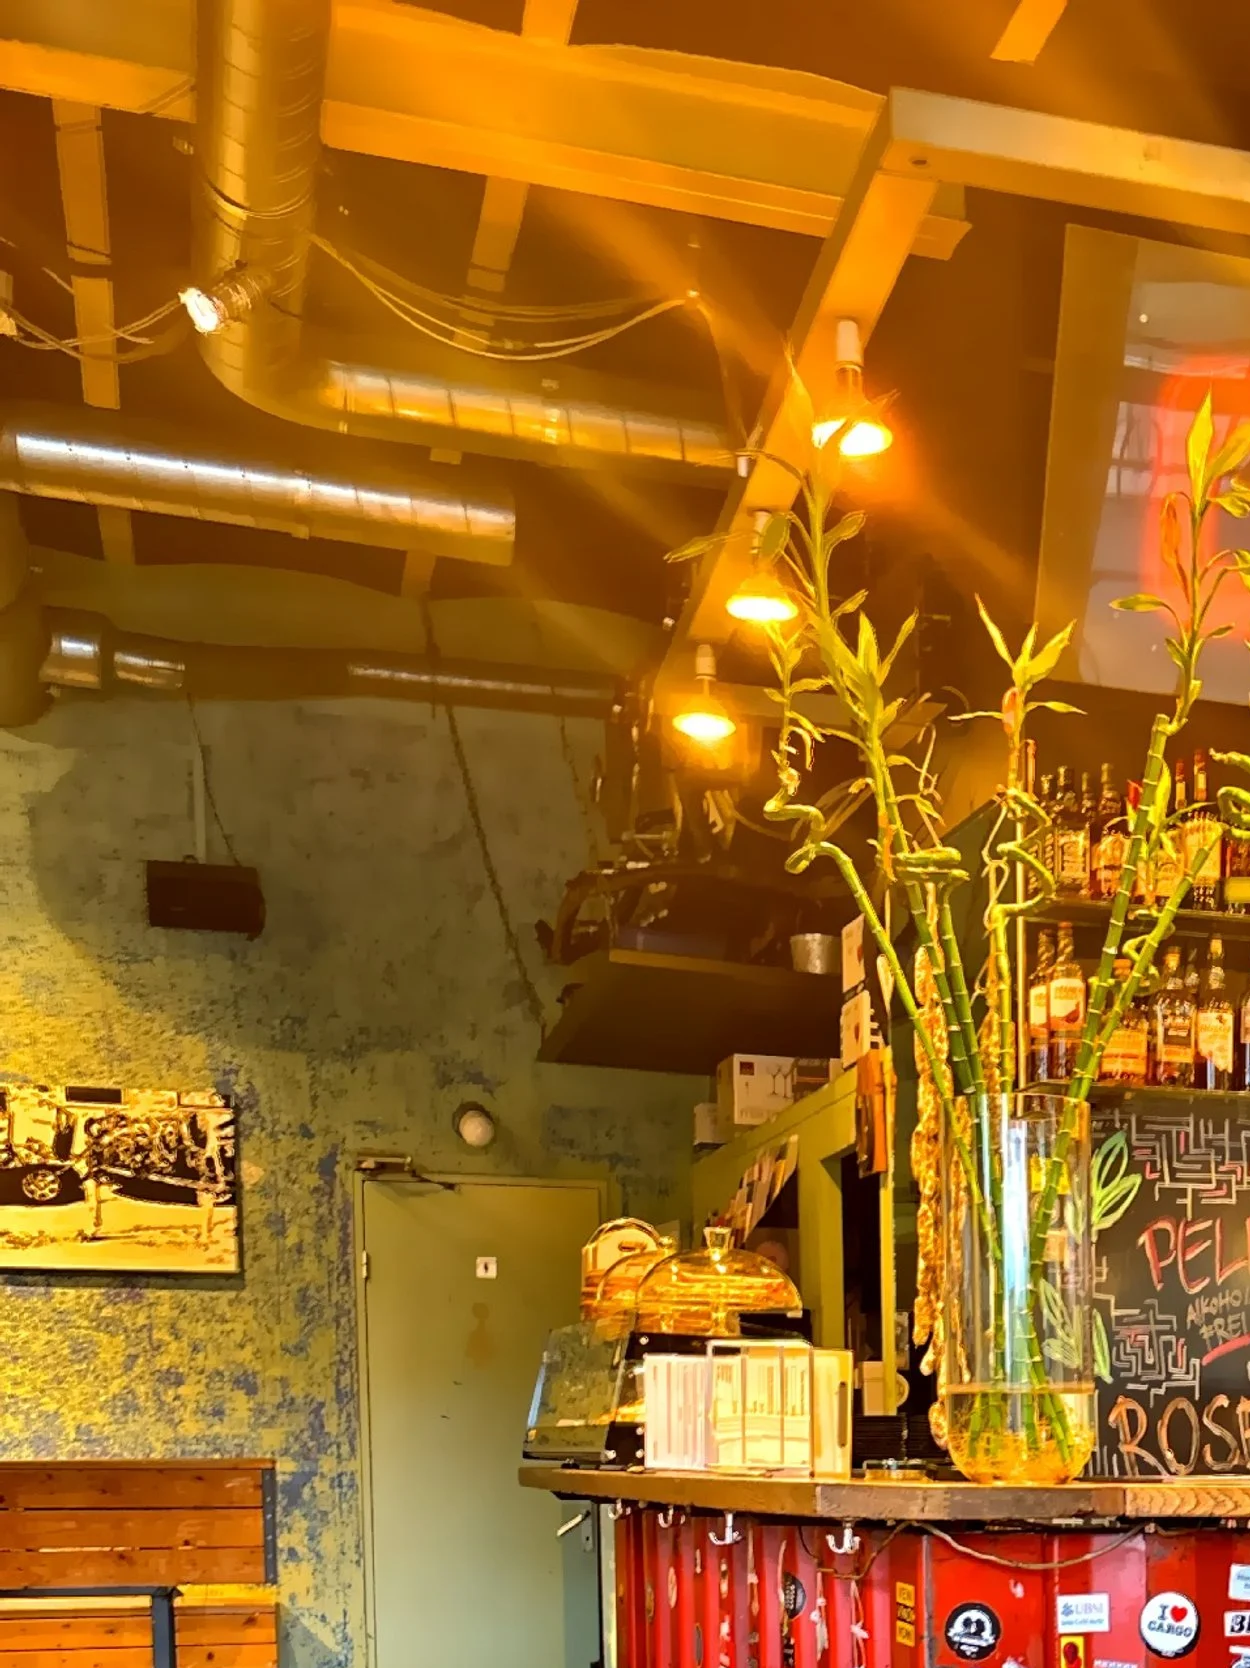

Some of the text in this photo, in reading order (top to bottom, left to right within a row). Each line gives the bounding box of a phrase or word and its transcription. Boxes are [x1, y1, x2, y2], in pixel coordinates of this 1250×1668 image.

[1199, 1311, 1248, 1348] FREI
[1158, 1604, 1170, 1620] I
[1147, 1620, 1193, 1637] CARGO
